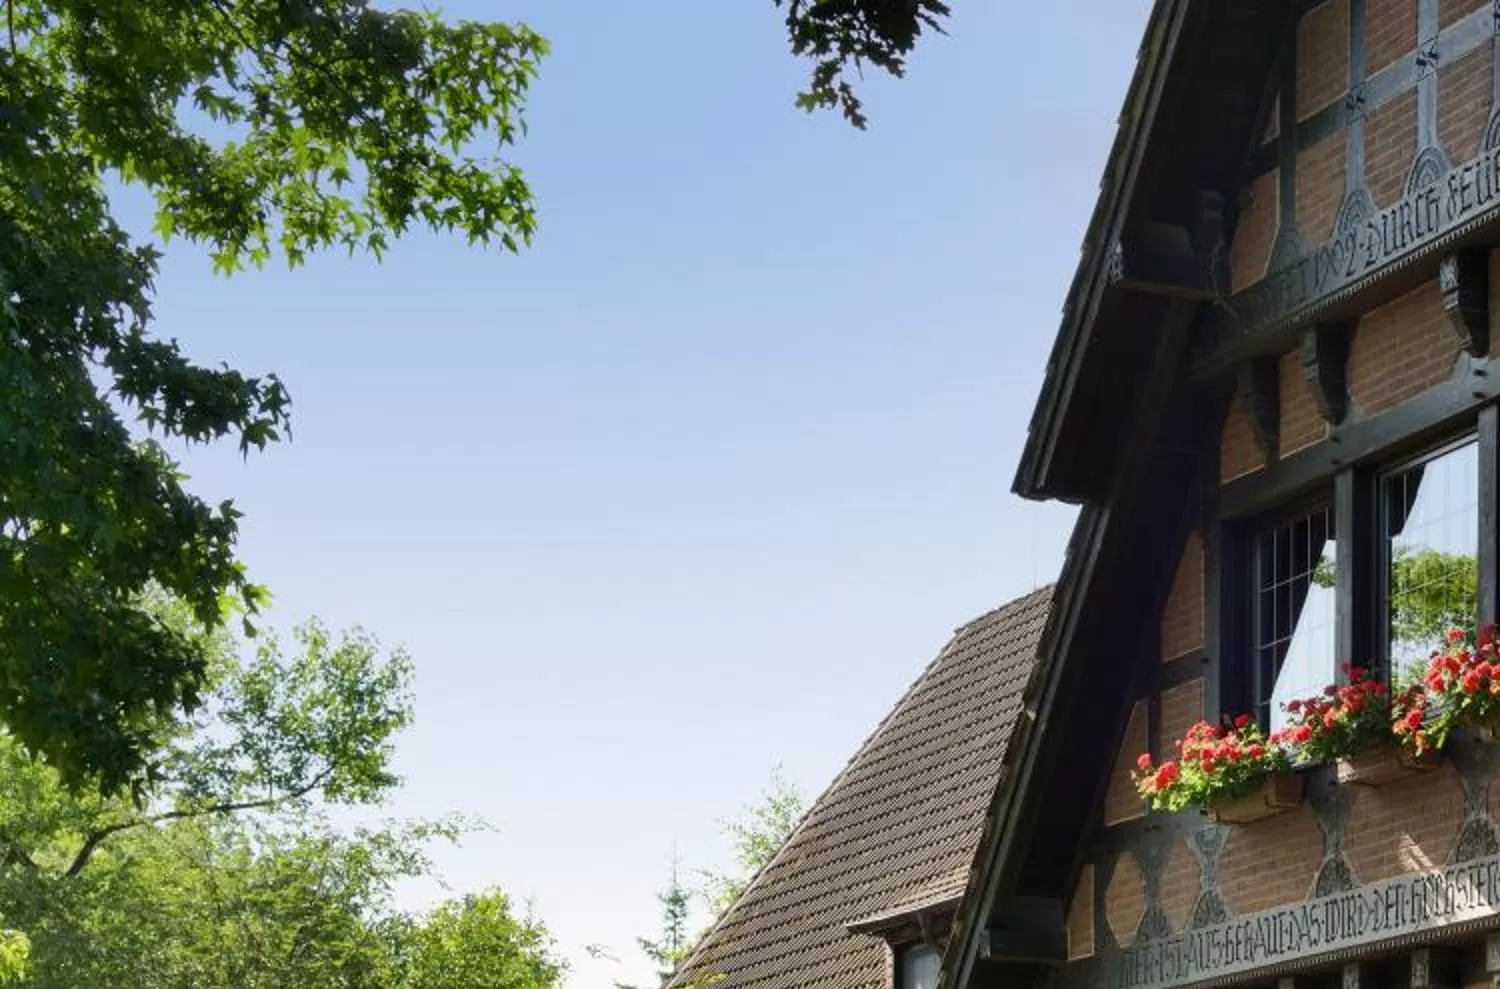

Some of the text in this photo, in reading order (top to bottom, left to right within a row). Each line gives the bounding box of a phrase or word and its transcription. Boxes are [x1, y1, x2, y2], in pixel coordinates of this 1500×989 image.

[1366, 186, 1441, 267] DURCH
[1287, 903, 1322, 953] DAS
[1325, 891, 1370, 944] WIRD
